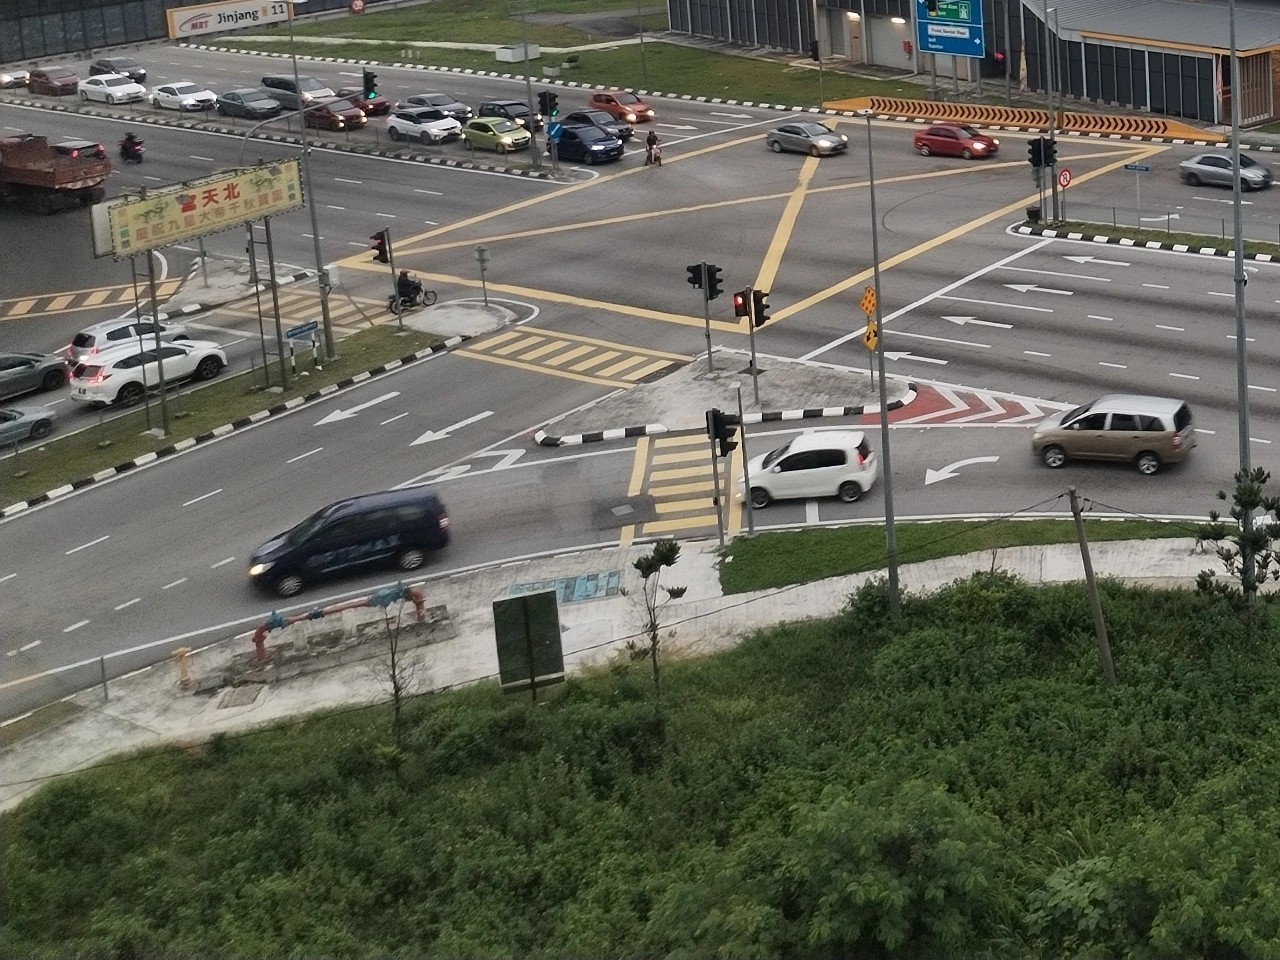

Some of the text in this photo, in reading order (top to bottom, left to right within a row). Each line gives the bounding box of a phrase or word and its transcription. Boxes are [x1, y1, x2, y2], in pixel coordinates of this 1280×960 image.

[190, 4, 285, 31] MRT Jinjang 11
